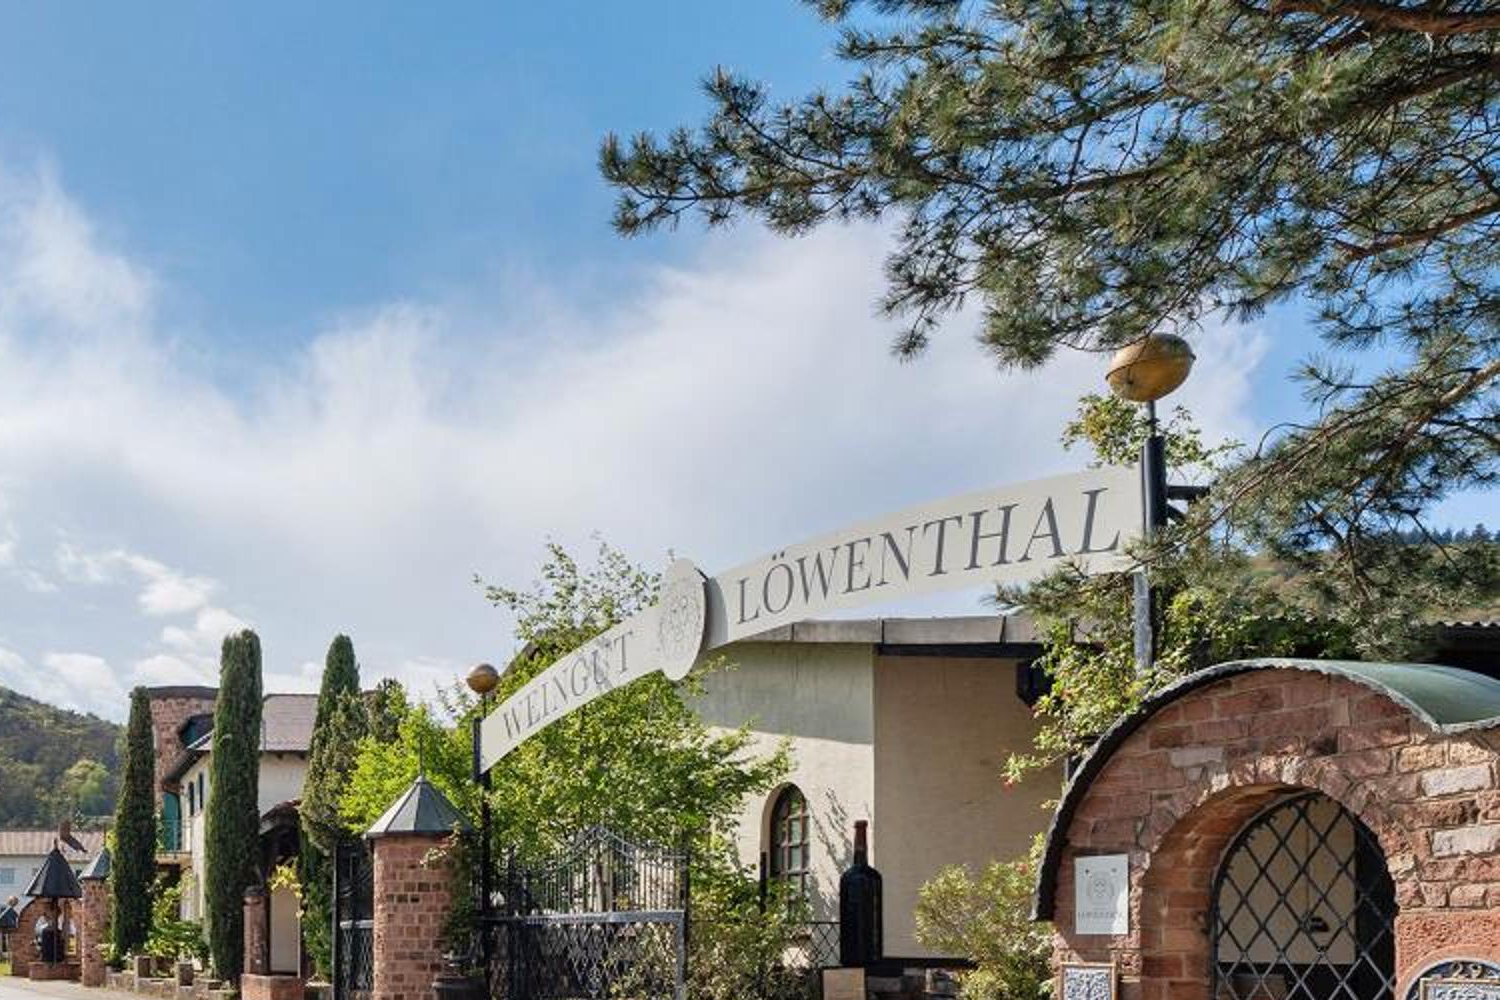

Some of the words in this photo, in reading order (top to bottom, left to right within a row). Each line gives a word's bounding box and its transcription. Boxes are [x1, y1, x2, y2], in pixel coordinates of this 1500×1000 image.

[503, 629, 634, 739] WEINGUT
[736, 486, 1121, 626] LÖWENTHAL
[1449, 961, 1484, 979] 29
